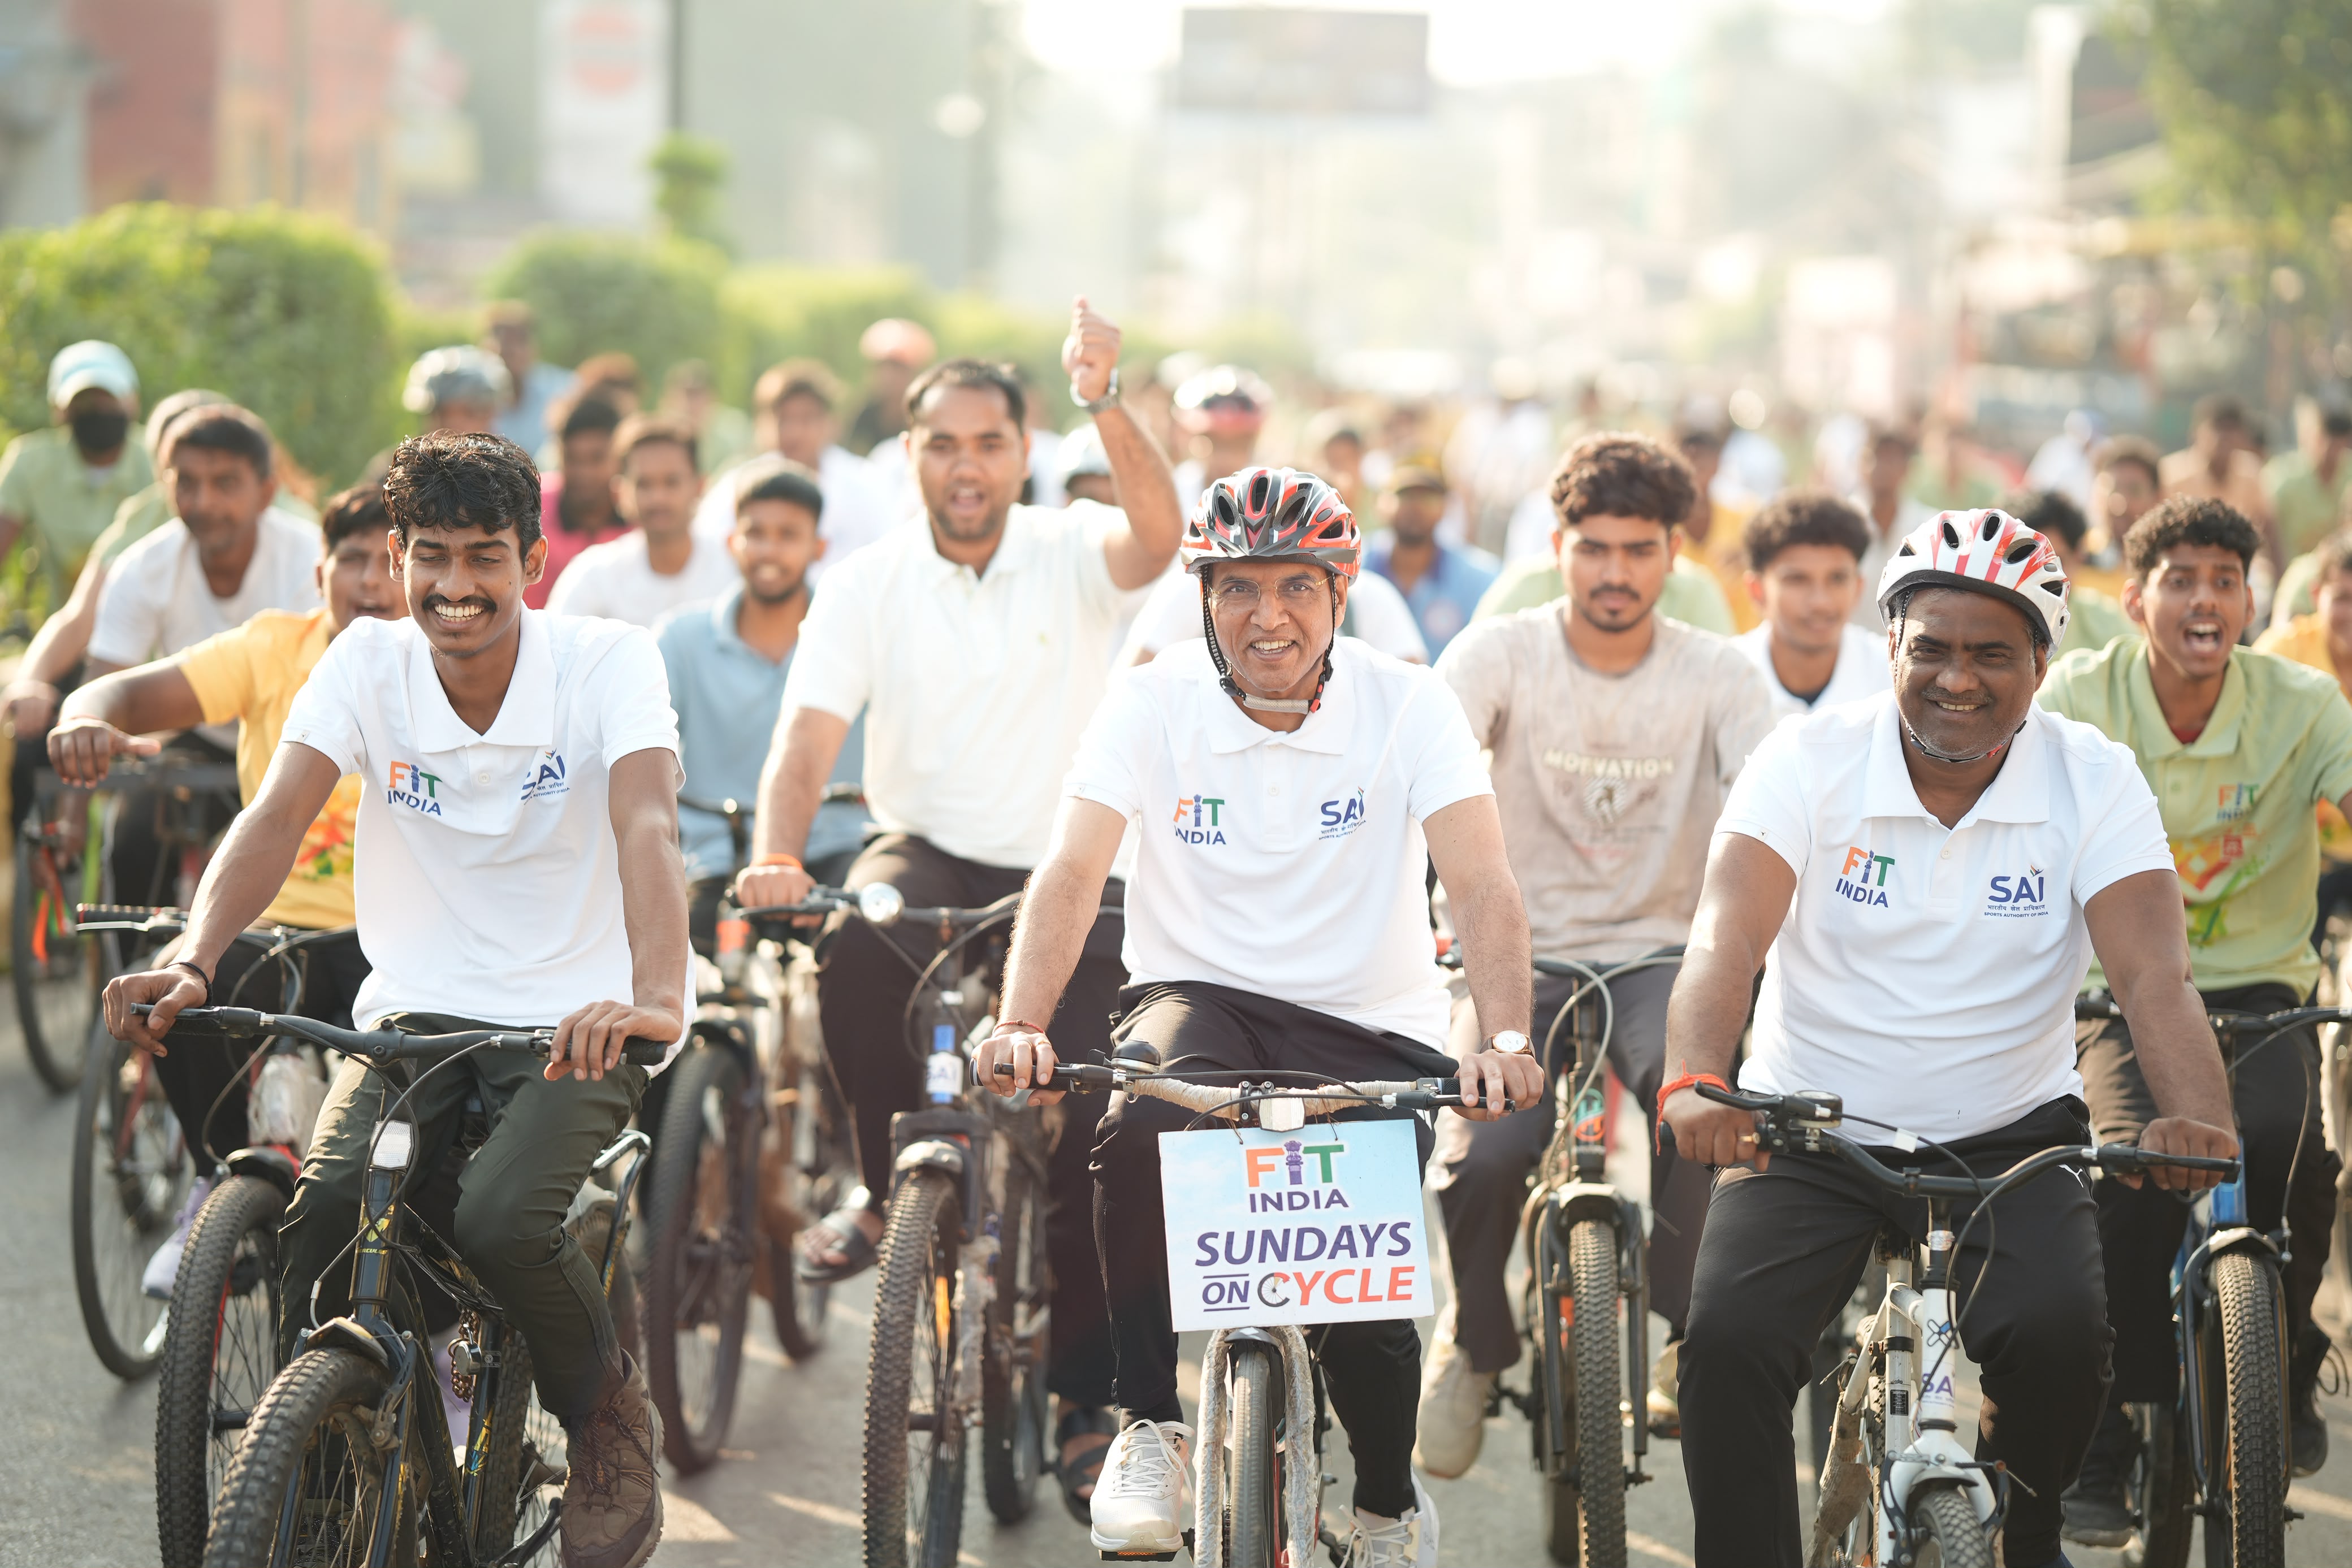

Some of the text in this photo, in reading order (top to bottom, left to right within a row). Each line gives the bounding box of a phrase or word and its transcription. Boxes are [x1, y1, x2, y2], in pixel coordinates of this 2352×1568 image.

[389, 760, 443, 799] FIT
[2218, 781, 2260, 808] FIT
[387, 790, 442, 817] INDIA
[1173, 794, 1225, 827] FIT
[1321, 797, 1364, 826] SAI
[1174, 825, 1226, 845] INDIA
[1841, 846, 1895, 887] FIT
[1835, 877, 1889, 908] INDIA
[1988, 876, 2044, 903] SAI
[1246, 1140, 1344, 1188] FIT
[1250, 1188, 1350, 1213] INDIA
[1195, 1222, 1412, 1267] SUNDAYS
[1202, 1266, 1415, 1307] ON CYCLE
[1922, 1372, 1954, 1398] SA
